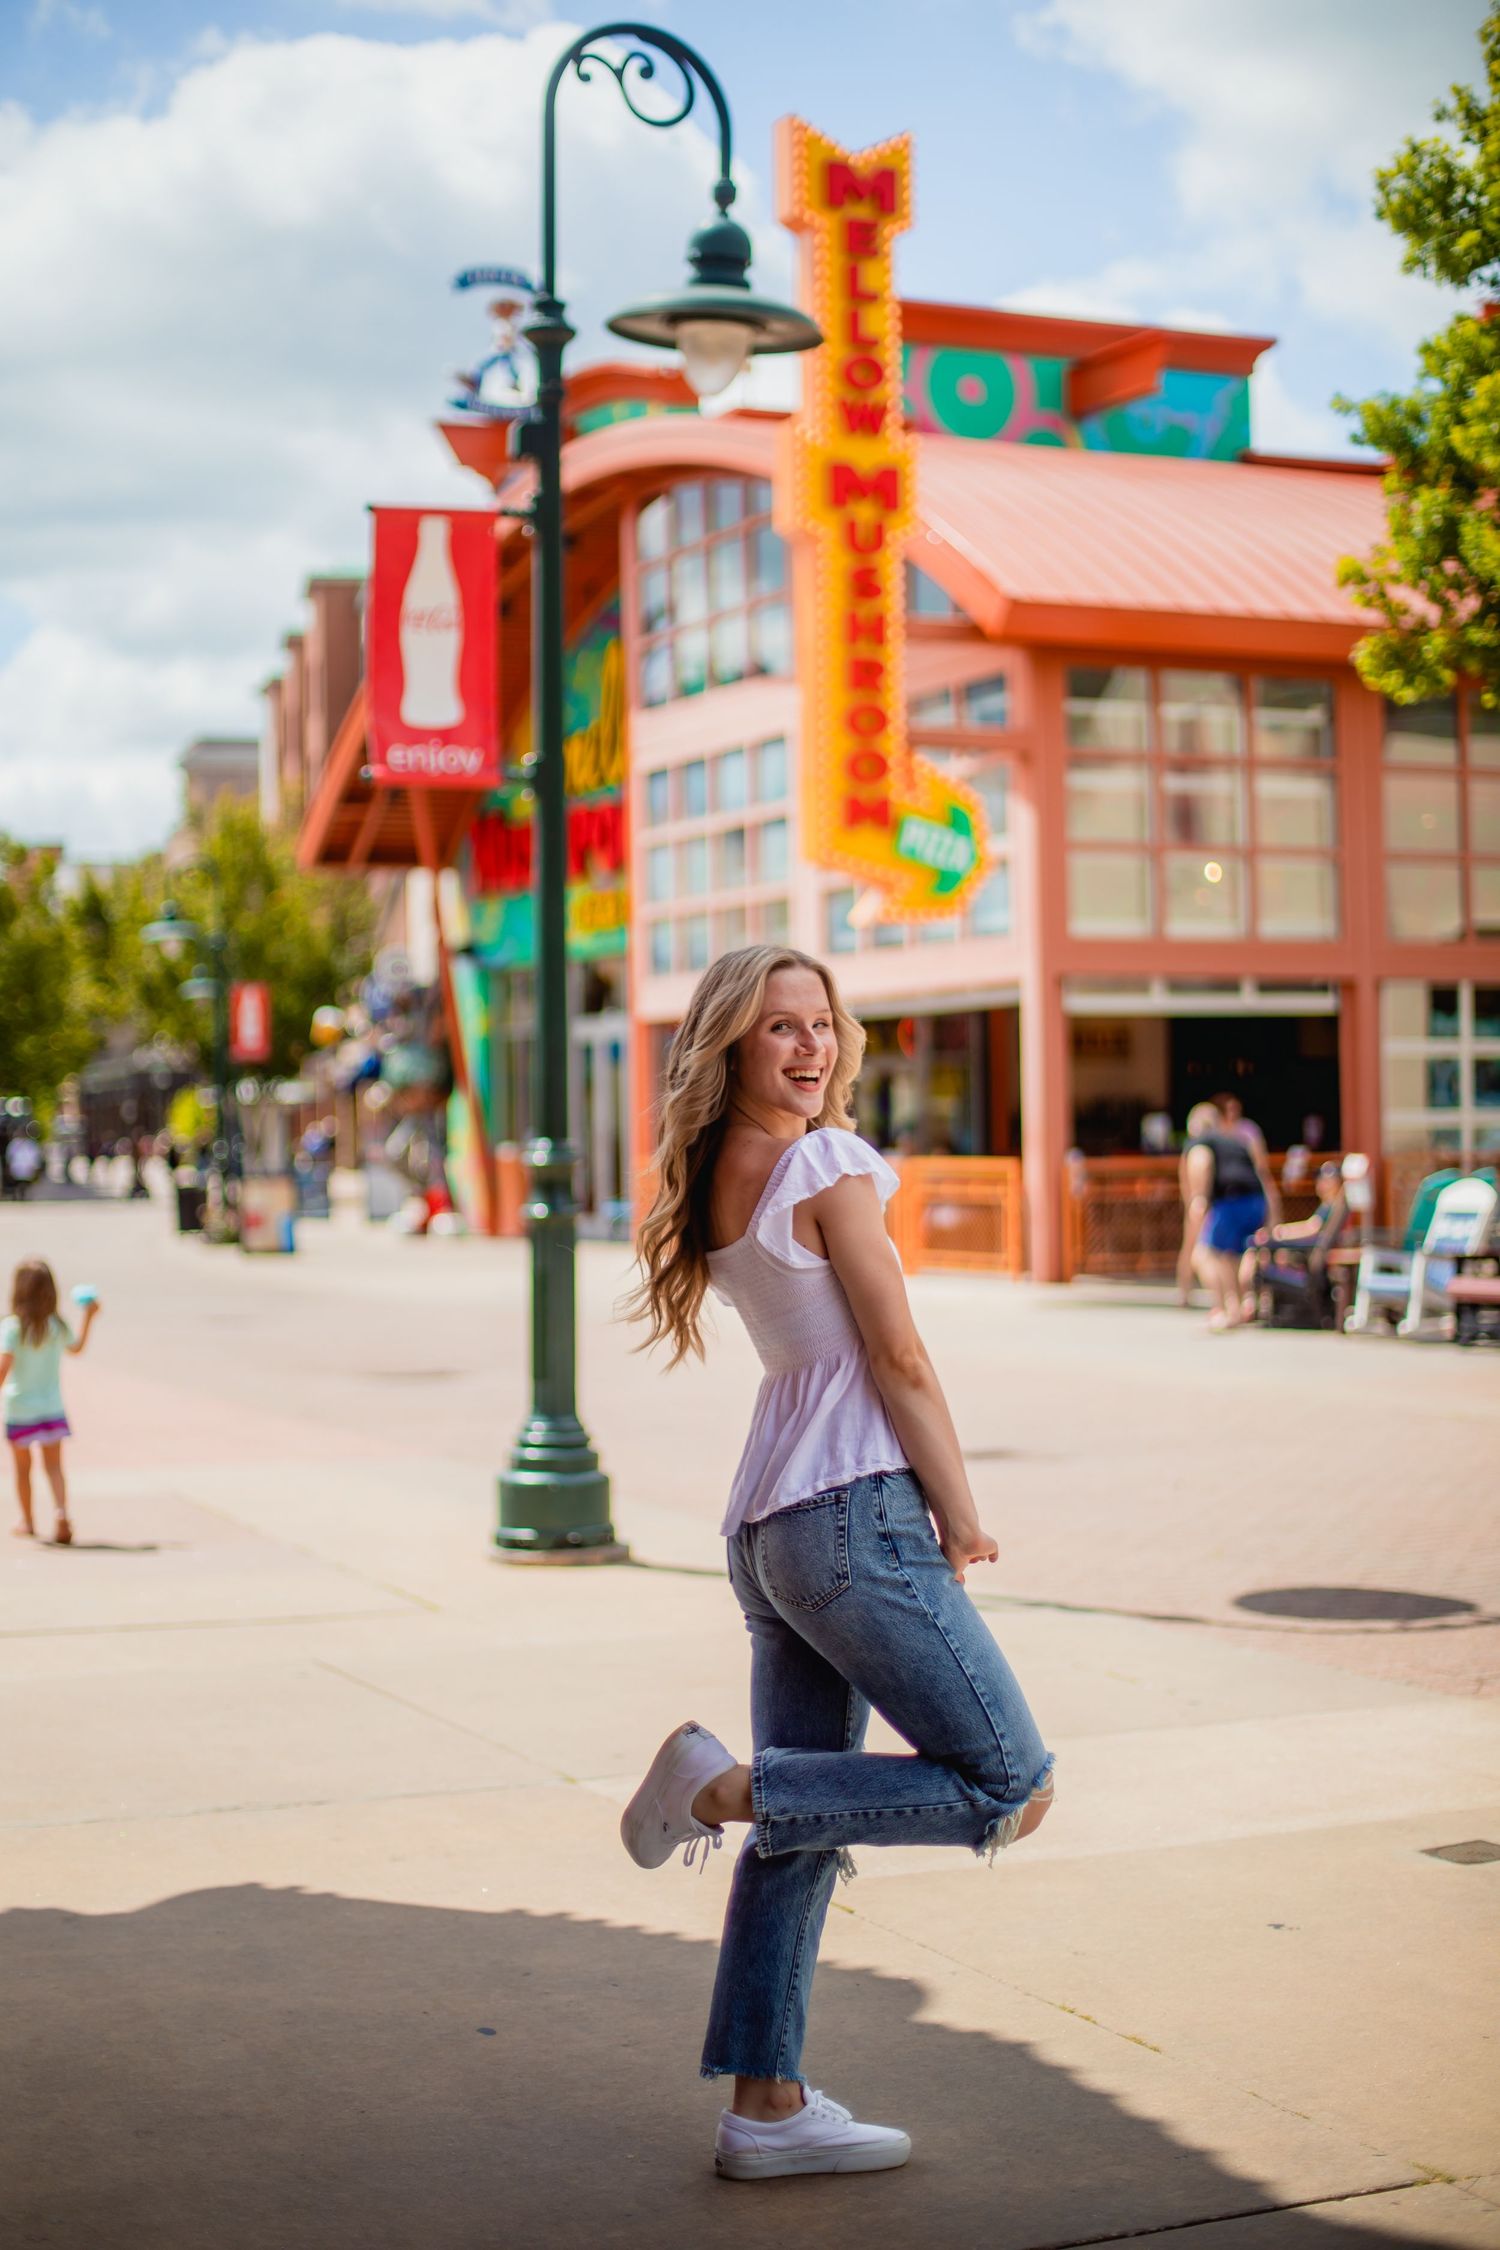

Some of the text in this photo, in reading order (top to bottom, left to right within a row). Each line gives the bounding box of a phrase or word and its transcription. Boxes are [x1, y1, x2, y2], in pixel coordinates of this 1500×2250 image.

[825, 160, 897, 829] MELLOW MUSHROOM
[386, 738, 484, 777] enjoy
[899, 815, 972, 871] PIZZA
